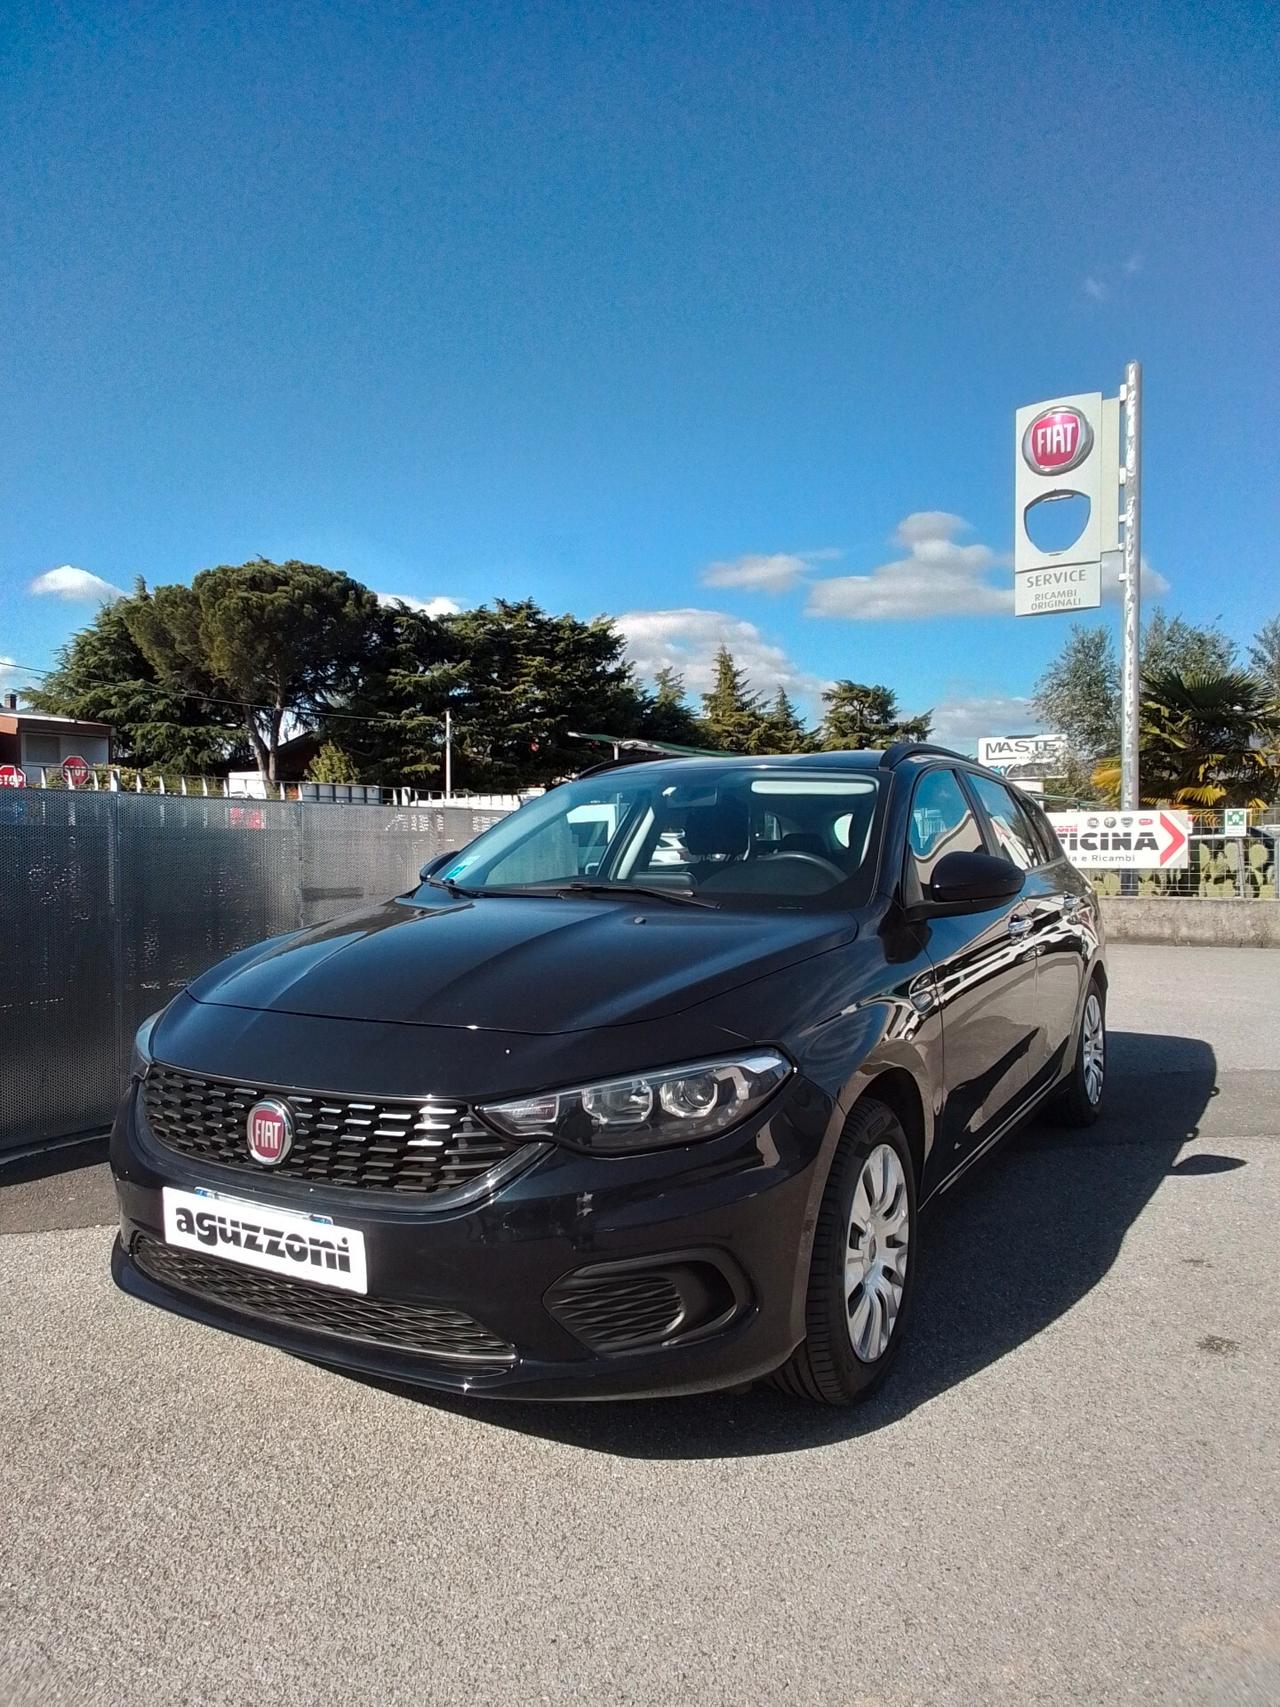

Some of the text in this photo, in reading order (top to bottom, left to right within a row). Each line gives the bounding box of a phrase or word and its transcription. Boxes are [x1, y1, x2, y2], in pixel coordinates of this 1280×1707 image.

[1037, 424, 1075, 456] FIAT
[1026, 569, 1087, 588] SERVICE
[1034, 589, 1077, 601] RICAMBI
[1031, 598, 1081, 611] ORIGINALI
[985, 740, 1061, 757] MASTE
[1092, 854, 1136, 862] Ricambi
[255, 1118, 281, 1150] FIAT
[175, 1207, 352, 1273] aguzzoni
